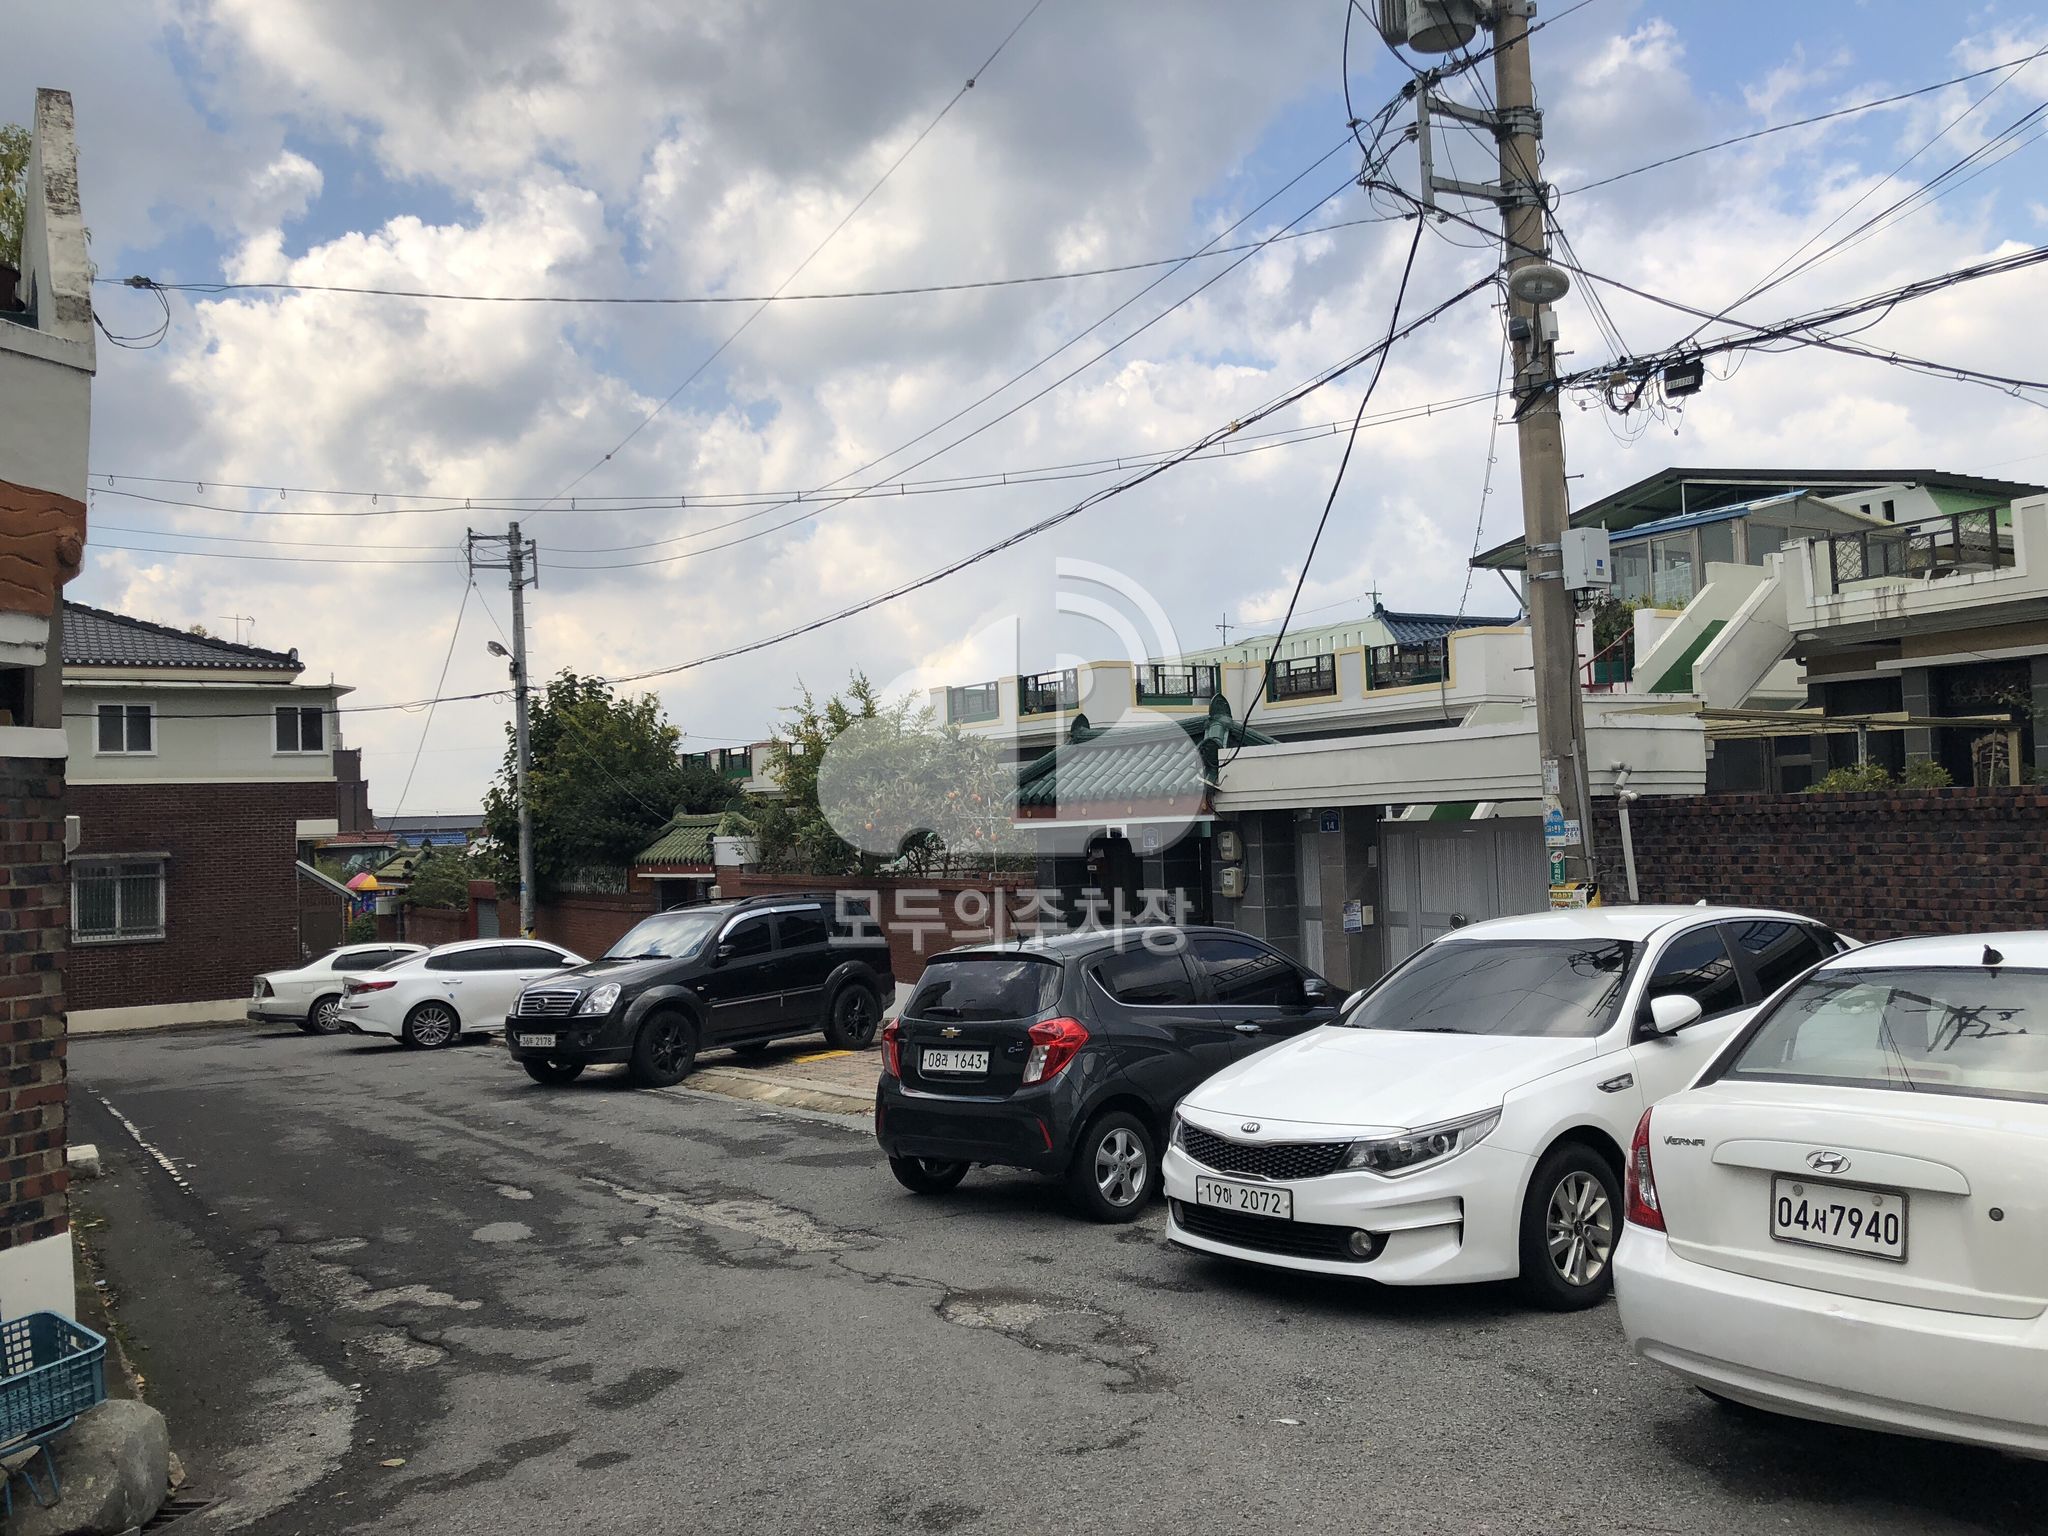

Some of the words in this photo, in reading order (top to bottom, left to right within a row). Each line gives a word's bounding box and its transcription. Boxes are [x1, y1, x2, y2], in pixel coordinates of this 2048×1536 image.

[535, 1036, 552, 1046] 2178
[928, 1052, 948, 1068] 08라
[954, 1053, 983, 1069] 1643
[1242, 1122, 1260, 1133] KIA
[1663, 1135, 1706, 1147] VERNA
[1205, 1183, 1232, 1206] 19하
[1240, 1188, 1281, 1214] 2072
[1777, 1196, 1900, 1246] 04서7940
